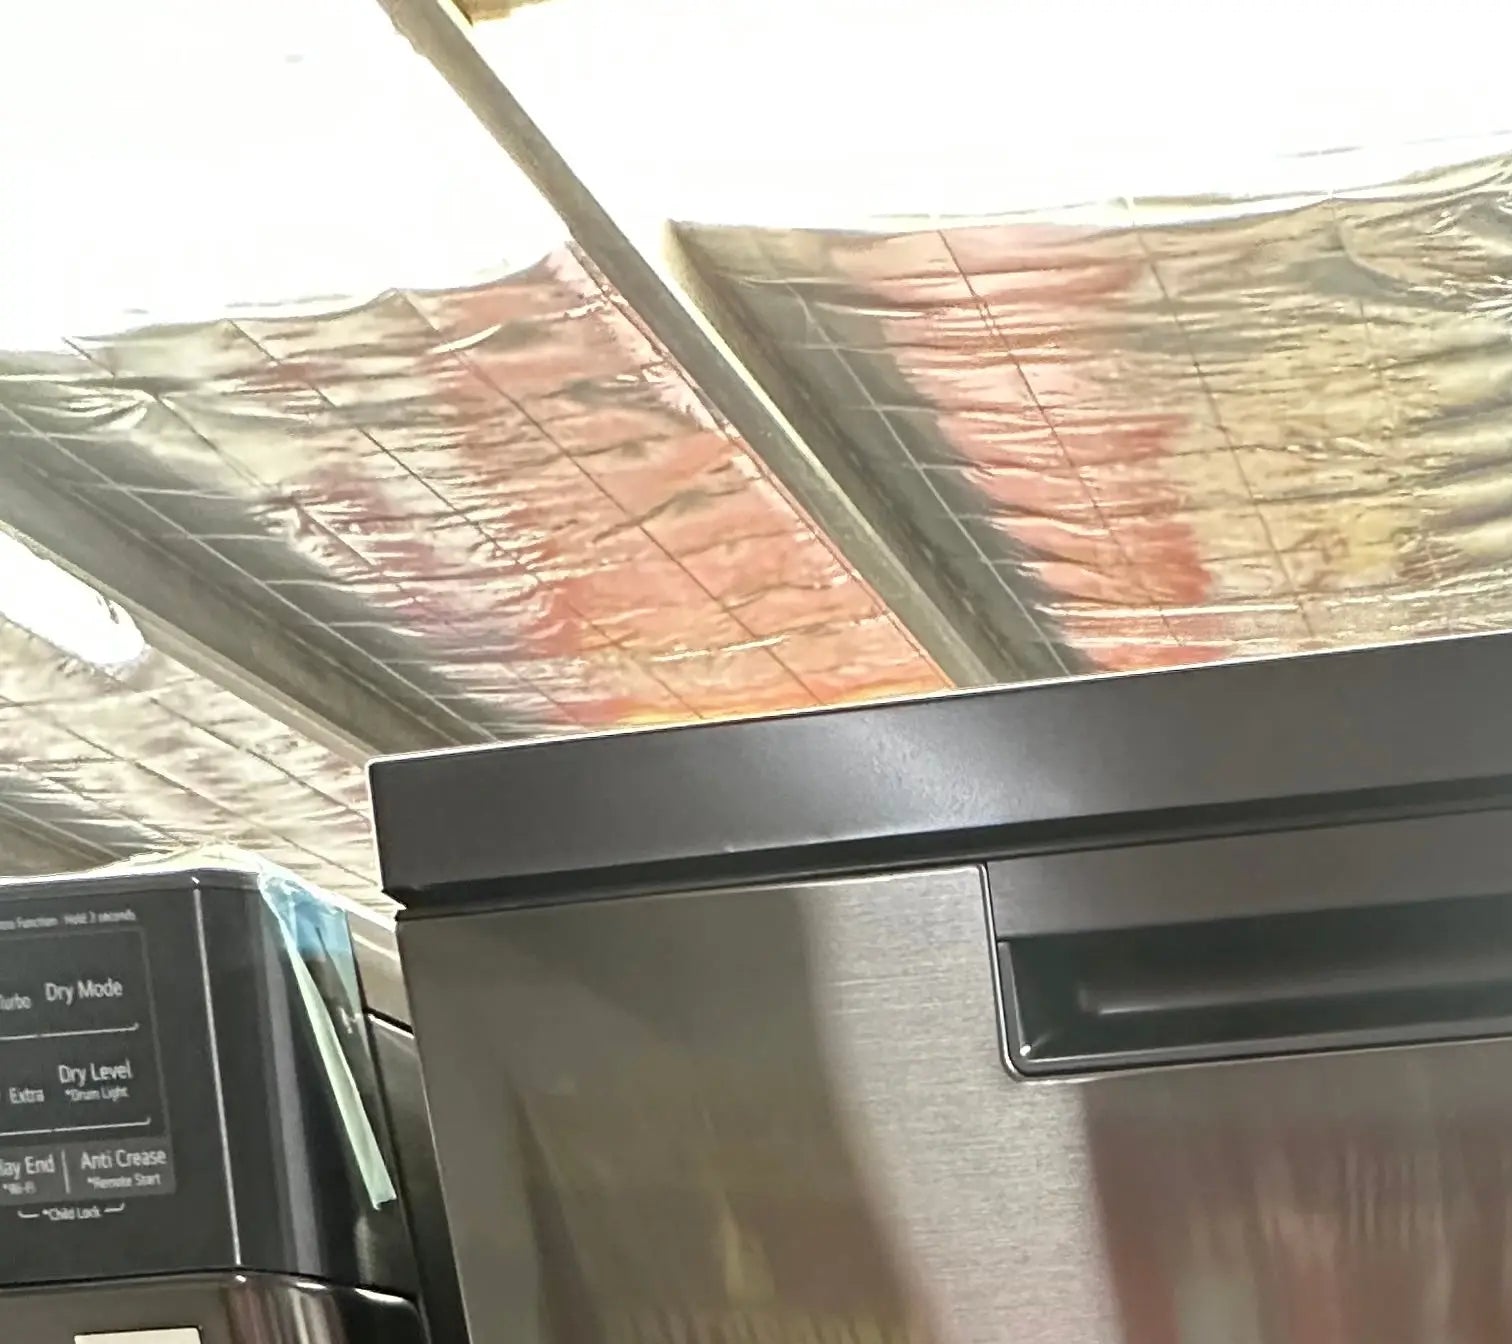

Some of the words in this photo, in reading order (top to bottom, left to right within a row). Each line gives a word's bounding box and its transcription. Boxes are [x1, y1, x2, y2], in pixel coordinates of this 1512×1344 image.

[44, 982, 74, 1006] Dry
[77, 977, 124, 999] Mode
[58, 1064, 86, 1087] Dry
[90, 1057, 133, 1081] Level
[9, 1087, 45, 1104] Extra
[0, 1158, 21, 1180] lay
[24, 1154, 55, 1175] End
[81, 1151, 112, 1170] Anti
[115, 1149, 168, 1168] Crease
